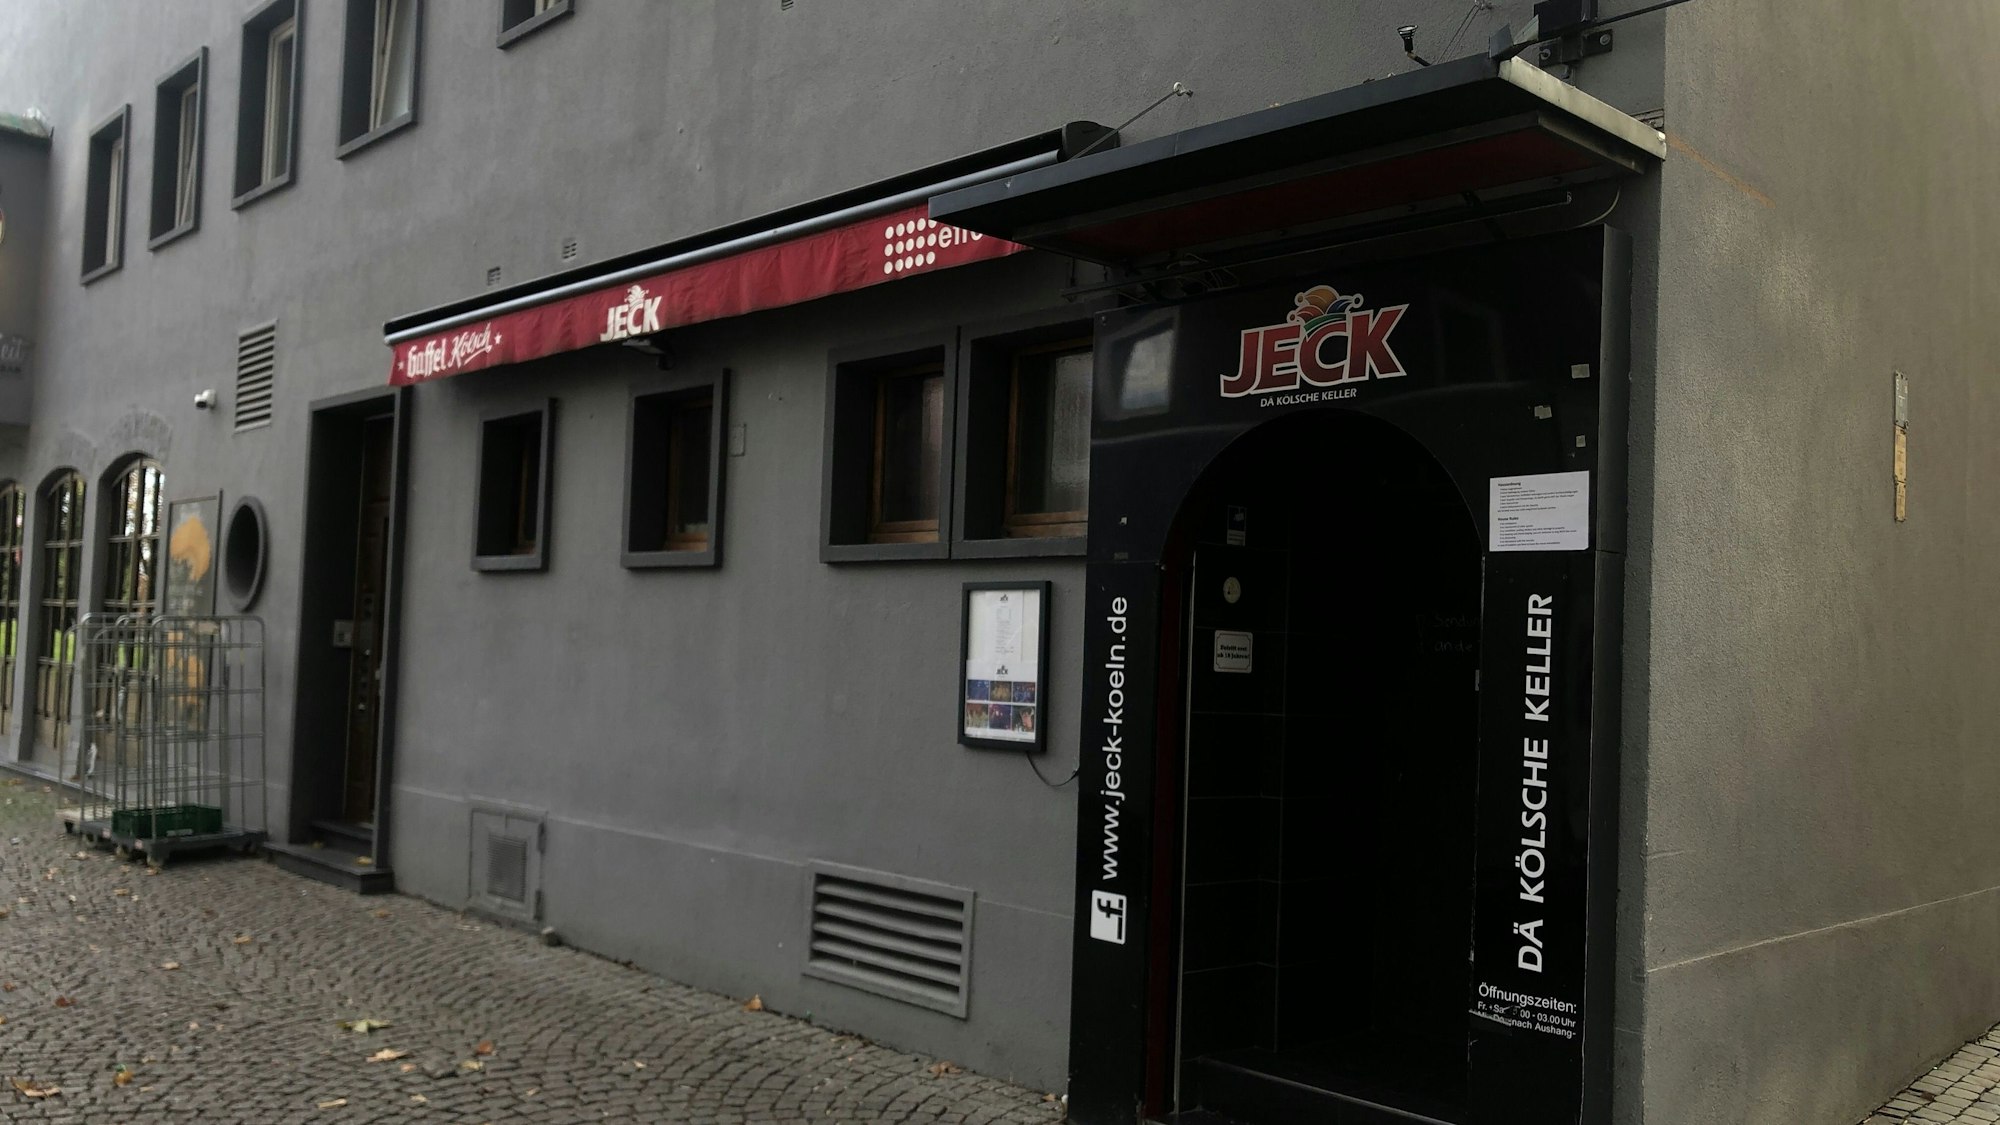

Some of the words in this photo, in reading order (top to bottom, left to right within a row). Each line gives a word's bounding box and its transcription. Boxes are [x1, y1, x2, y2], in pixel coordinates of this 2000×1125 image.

[600, 296, 662, 342] JECK
[406, 337, 447, 378] Gaffel
[447, 321, 493, 369] Kölsch
[1220, 303, 1410, 397] JECK
[1321, 388, 1357, 401] KELLER
[1525, 592, 1553, 722] KELLER
[1100, 596, 1128, 880] www.jeck-koeln.de
[1515, 737, 1549, 904] KÖLSCHE
[1513, 919, 1543, 973] DÄ
[1478, 982, 1577, 1014] Öffnungszeiten:
[1536, 1012, 1560, 1025] 03.00
[1560, 1017, 1576, 1028] Uhr
